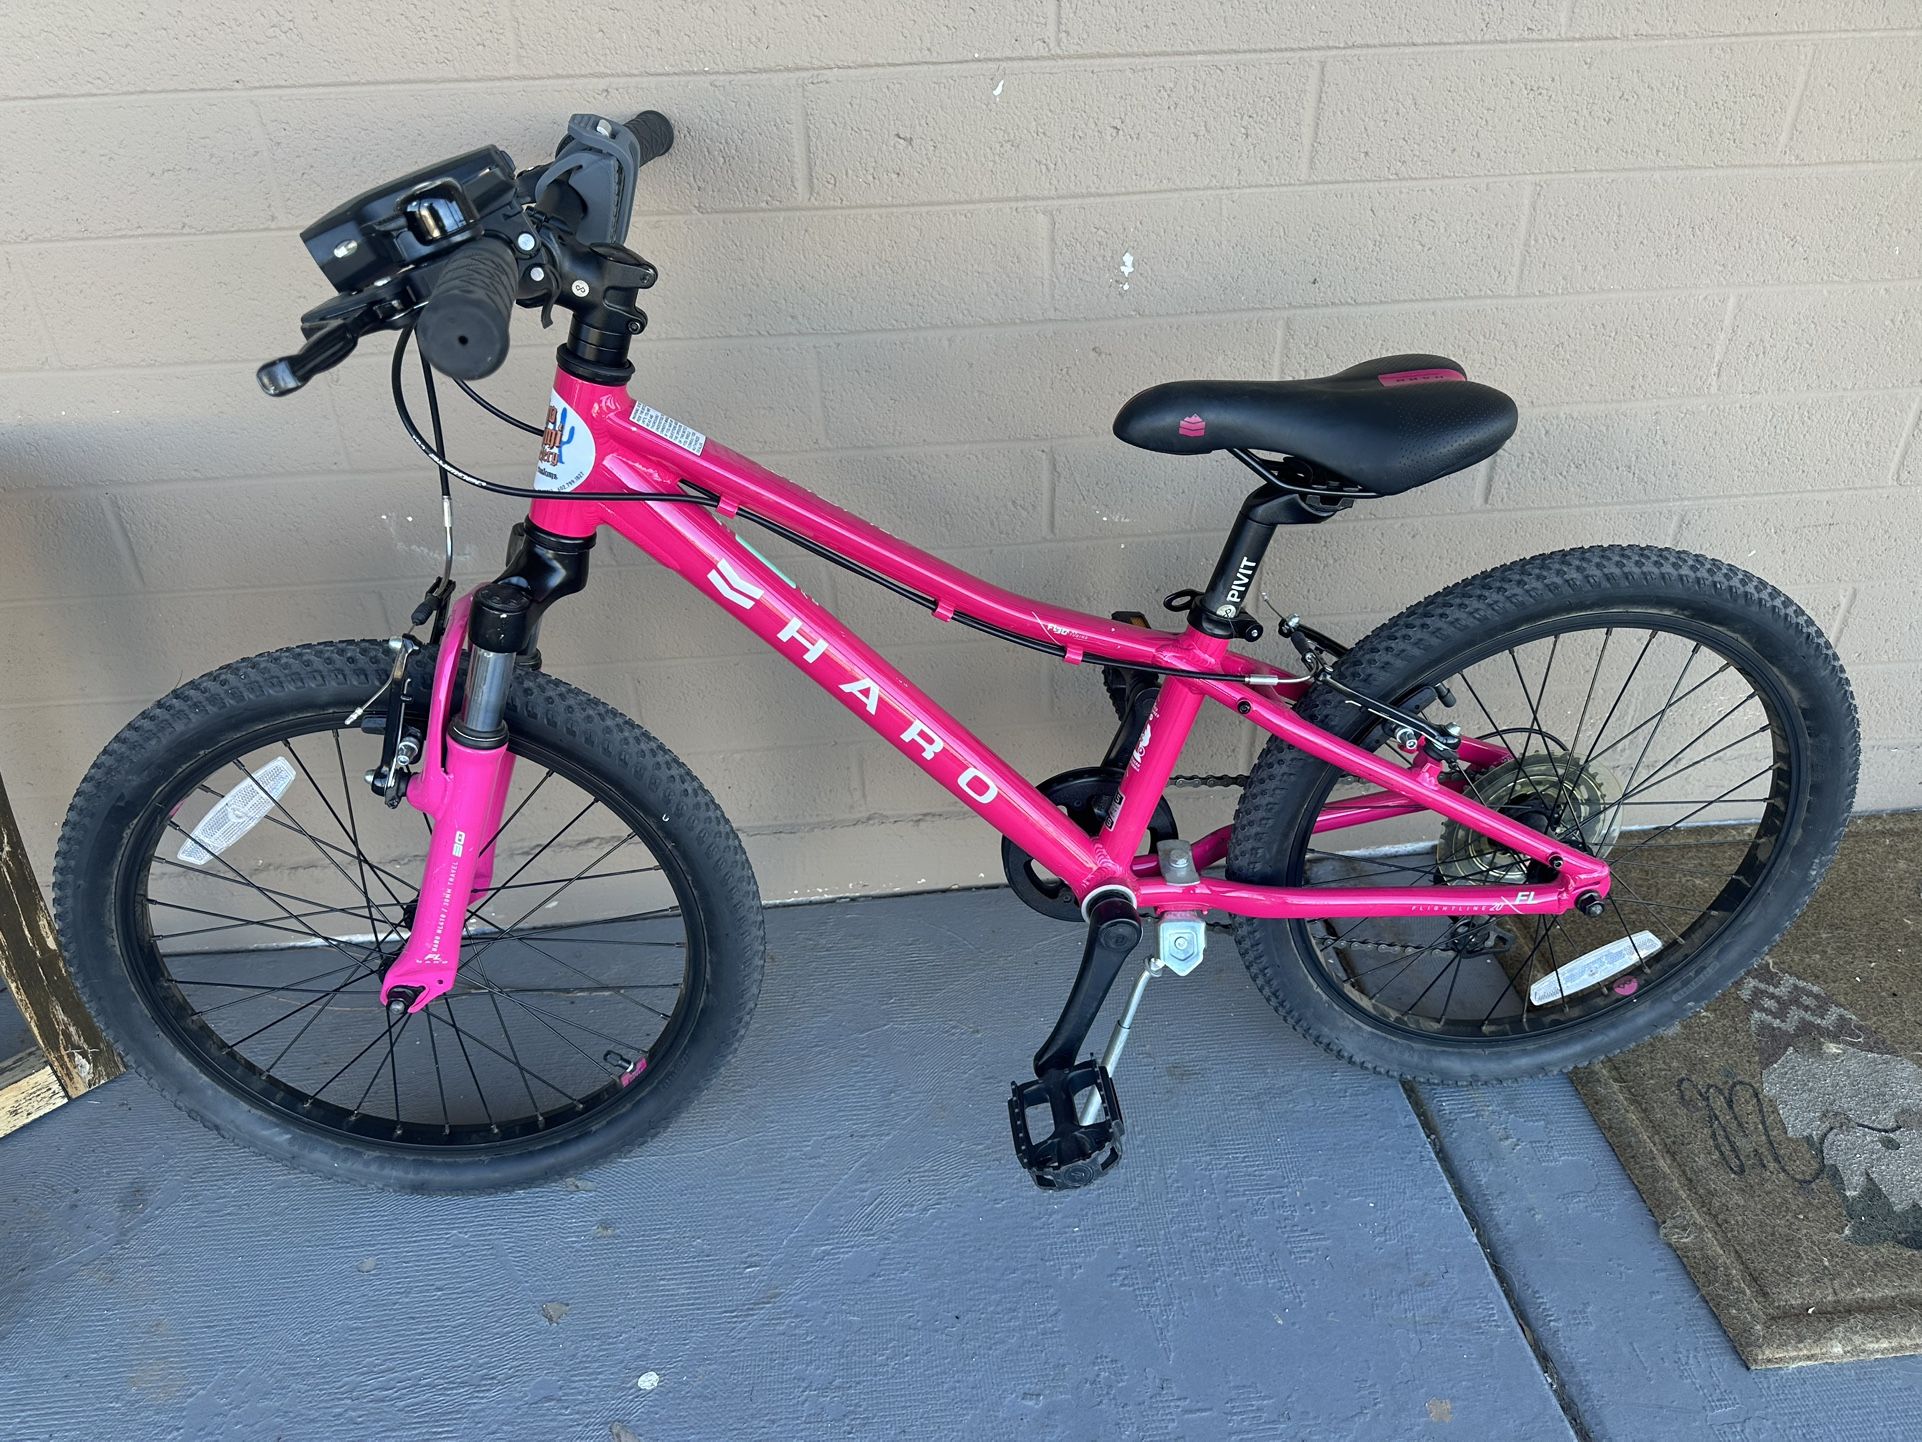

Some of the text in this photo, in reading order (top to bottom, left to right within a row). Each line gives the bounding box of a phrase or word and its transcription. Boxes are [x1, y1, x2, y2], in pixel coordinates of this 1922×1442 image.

[1226, 556, 1256, 602] PIVIT
[777, 617, 998, 803] HARO
[1489, 902, 1504, 911] 20
[1514, 891, 1536, 904] FL
